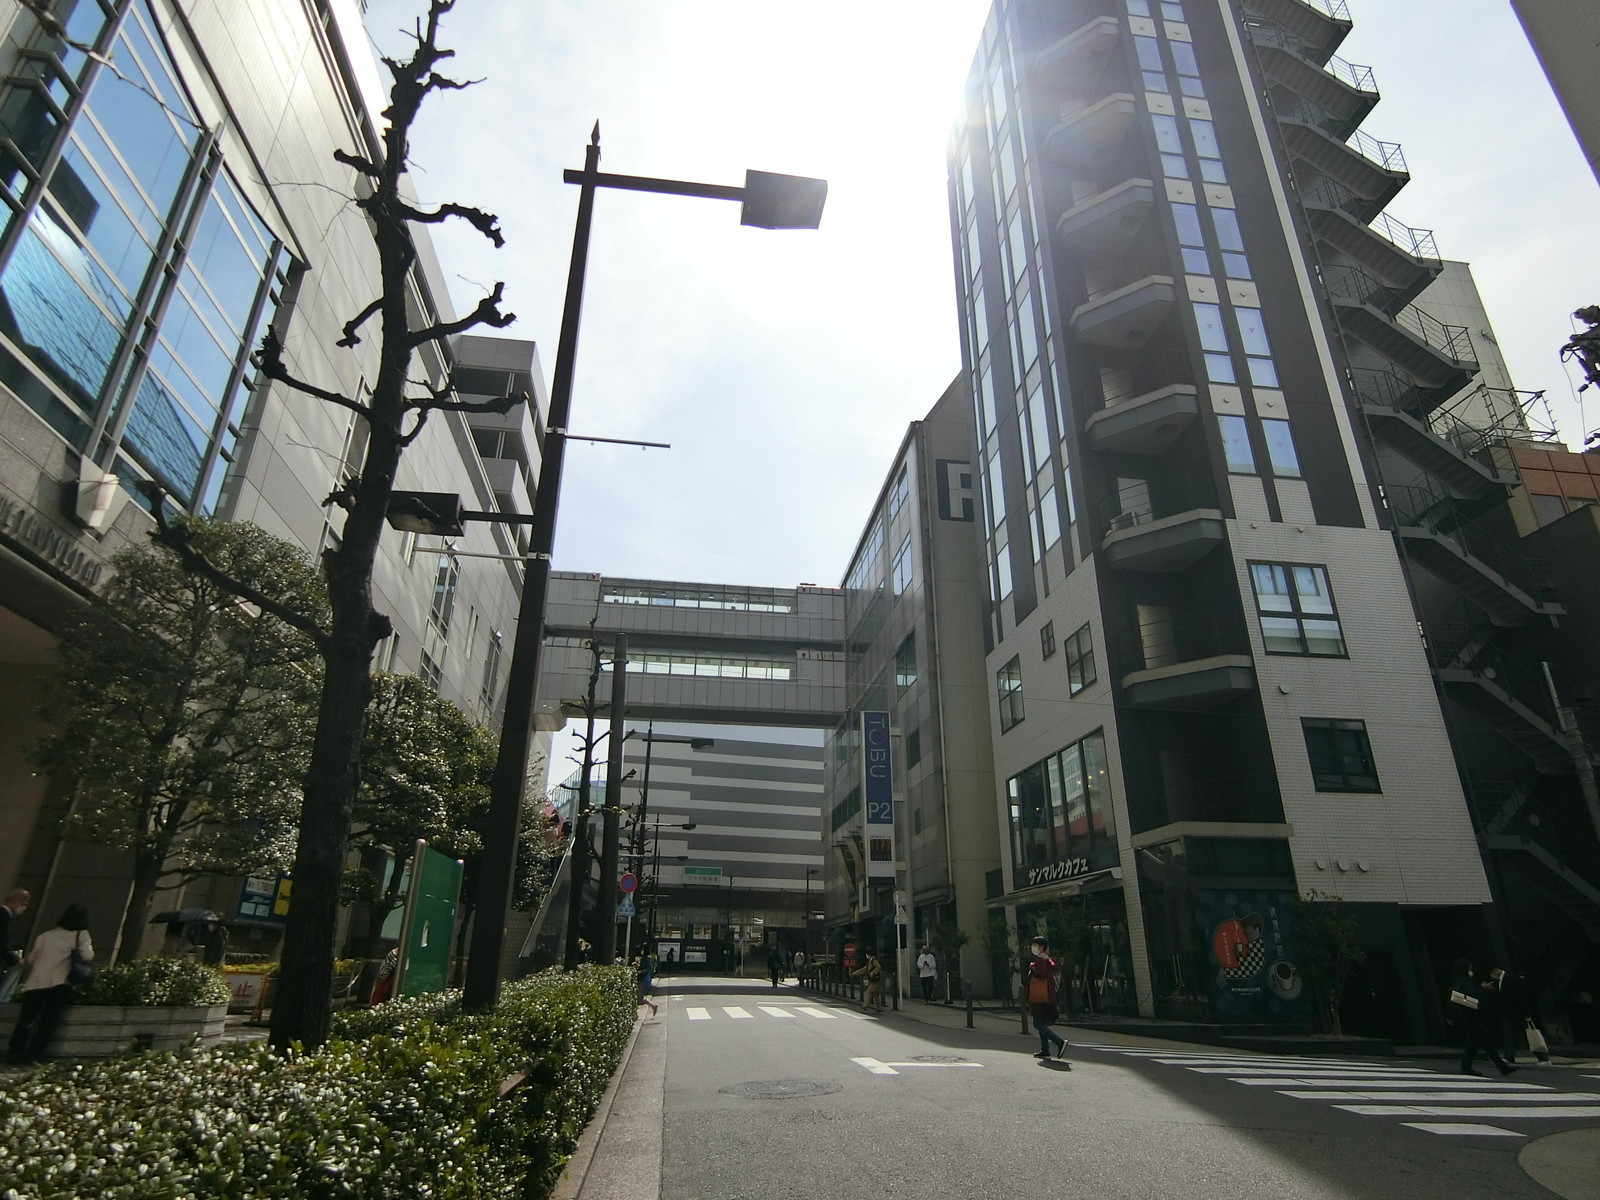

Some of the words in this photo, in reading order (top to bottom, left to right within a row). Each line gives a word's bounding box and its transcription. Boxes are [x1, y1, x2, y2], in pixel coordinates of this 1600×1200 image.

[868, 716, 886, 778] TOBU
[868, 802, 891, 819] P2
[1029, 858, 1088, 885] サンマルクカフェ
